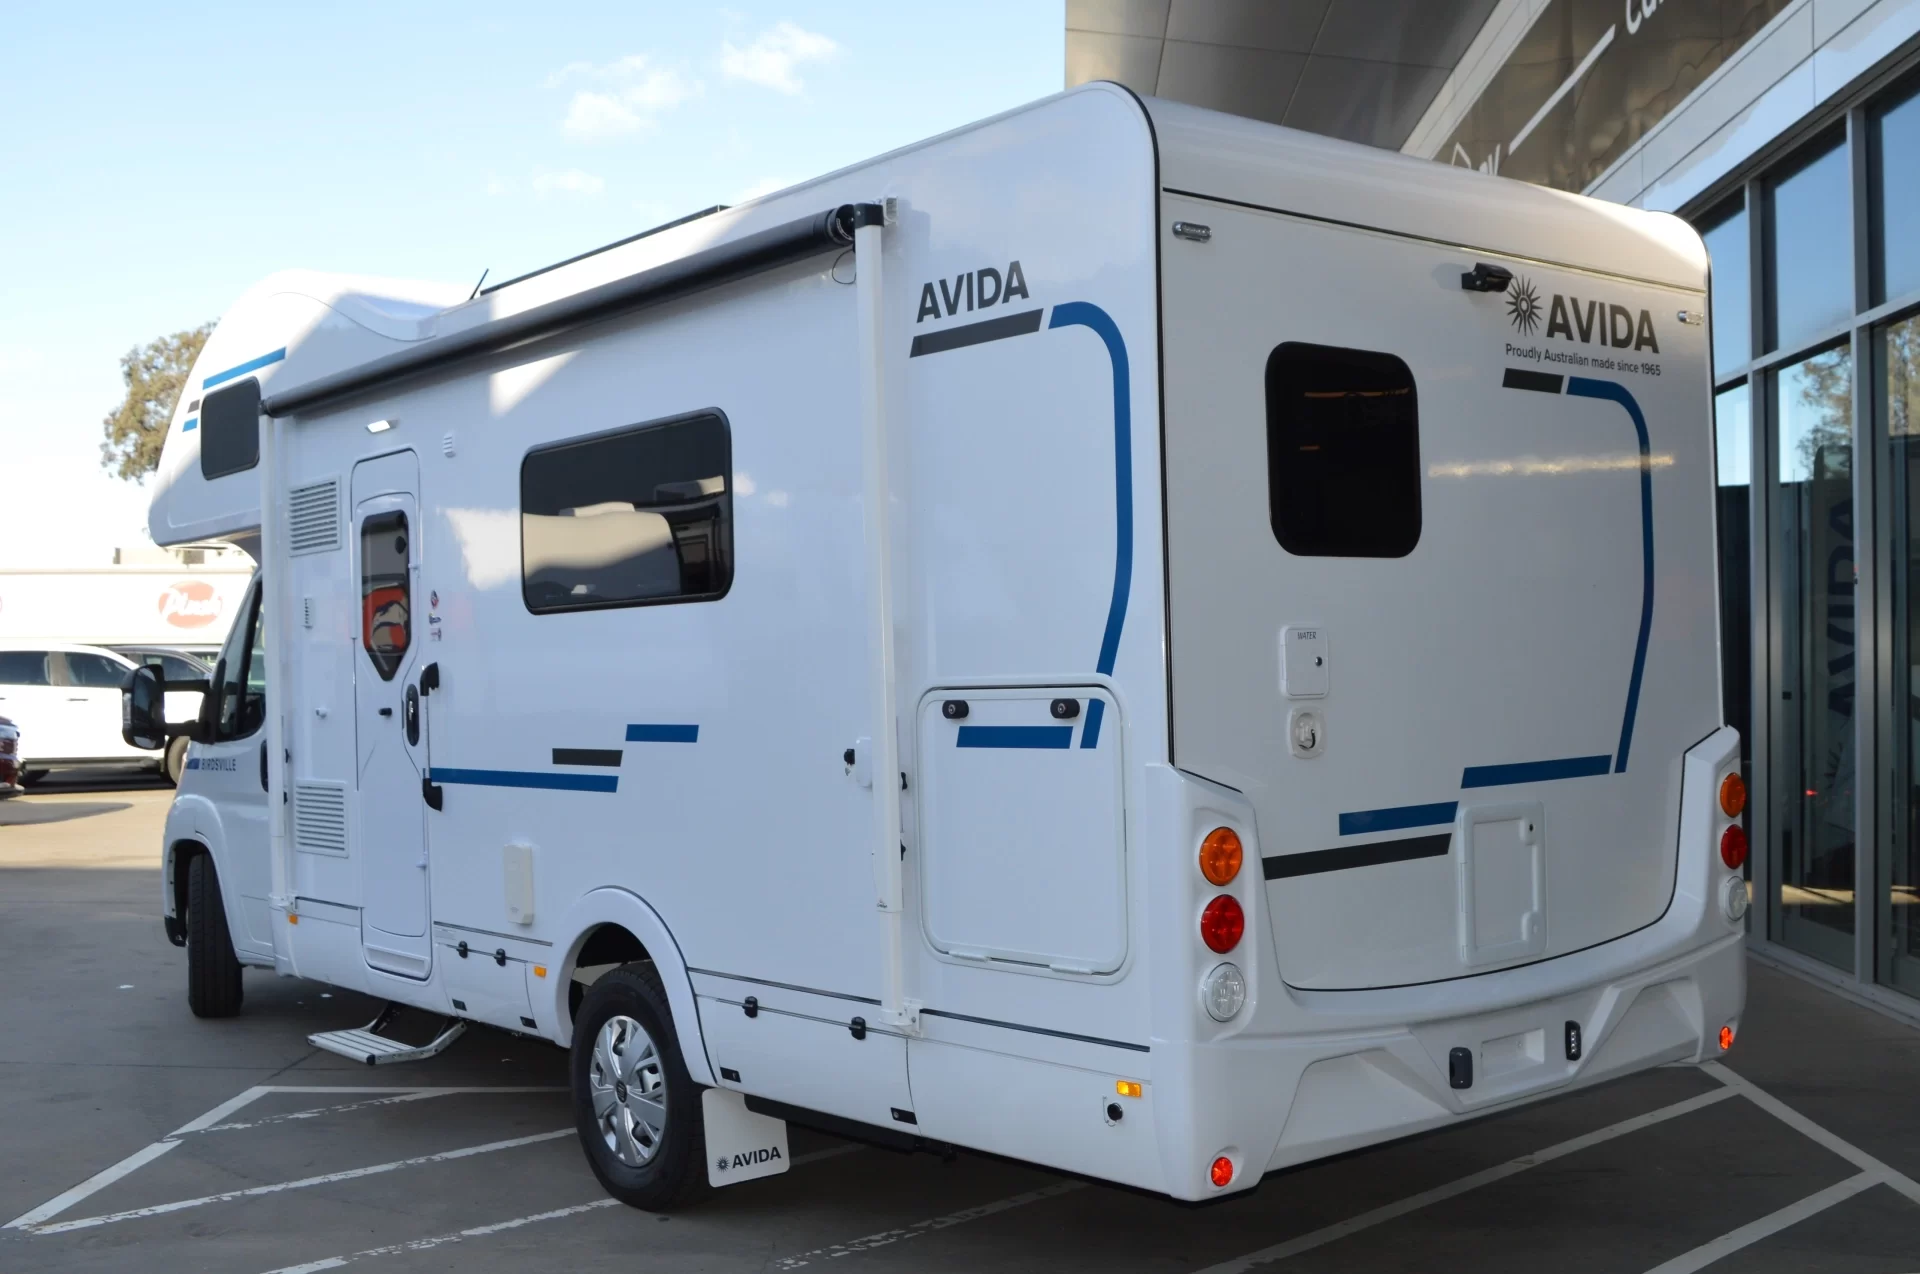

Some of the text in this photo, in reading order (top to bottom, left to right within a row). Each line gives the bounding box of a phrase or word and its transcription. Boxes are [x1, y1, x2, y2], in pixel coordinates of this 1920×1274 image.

[916, 260, 1030, 324] AVIDA
[1546, 293, 1660, 354] AVIDA
[1505, 343, 1661, 376] Proudly Australian made since 1965
[1297, 631, 1317, 640] WATER
[201, 758, 236, 772] BIRDSVILLE
[732, 1146, 782, 1169] AVIDA
